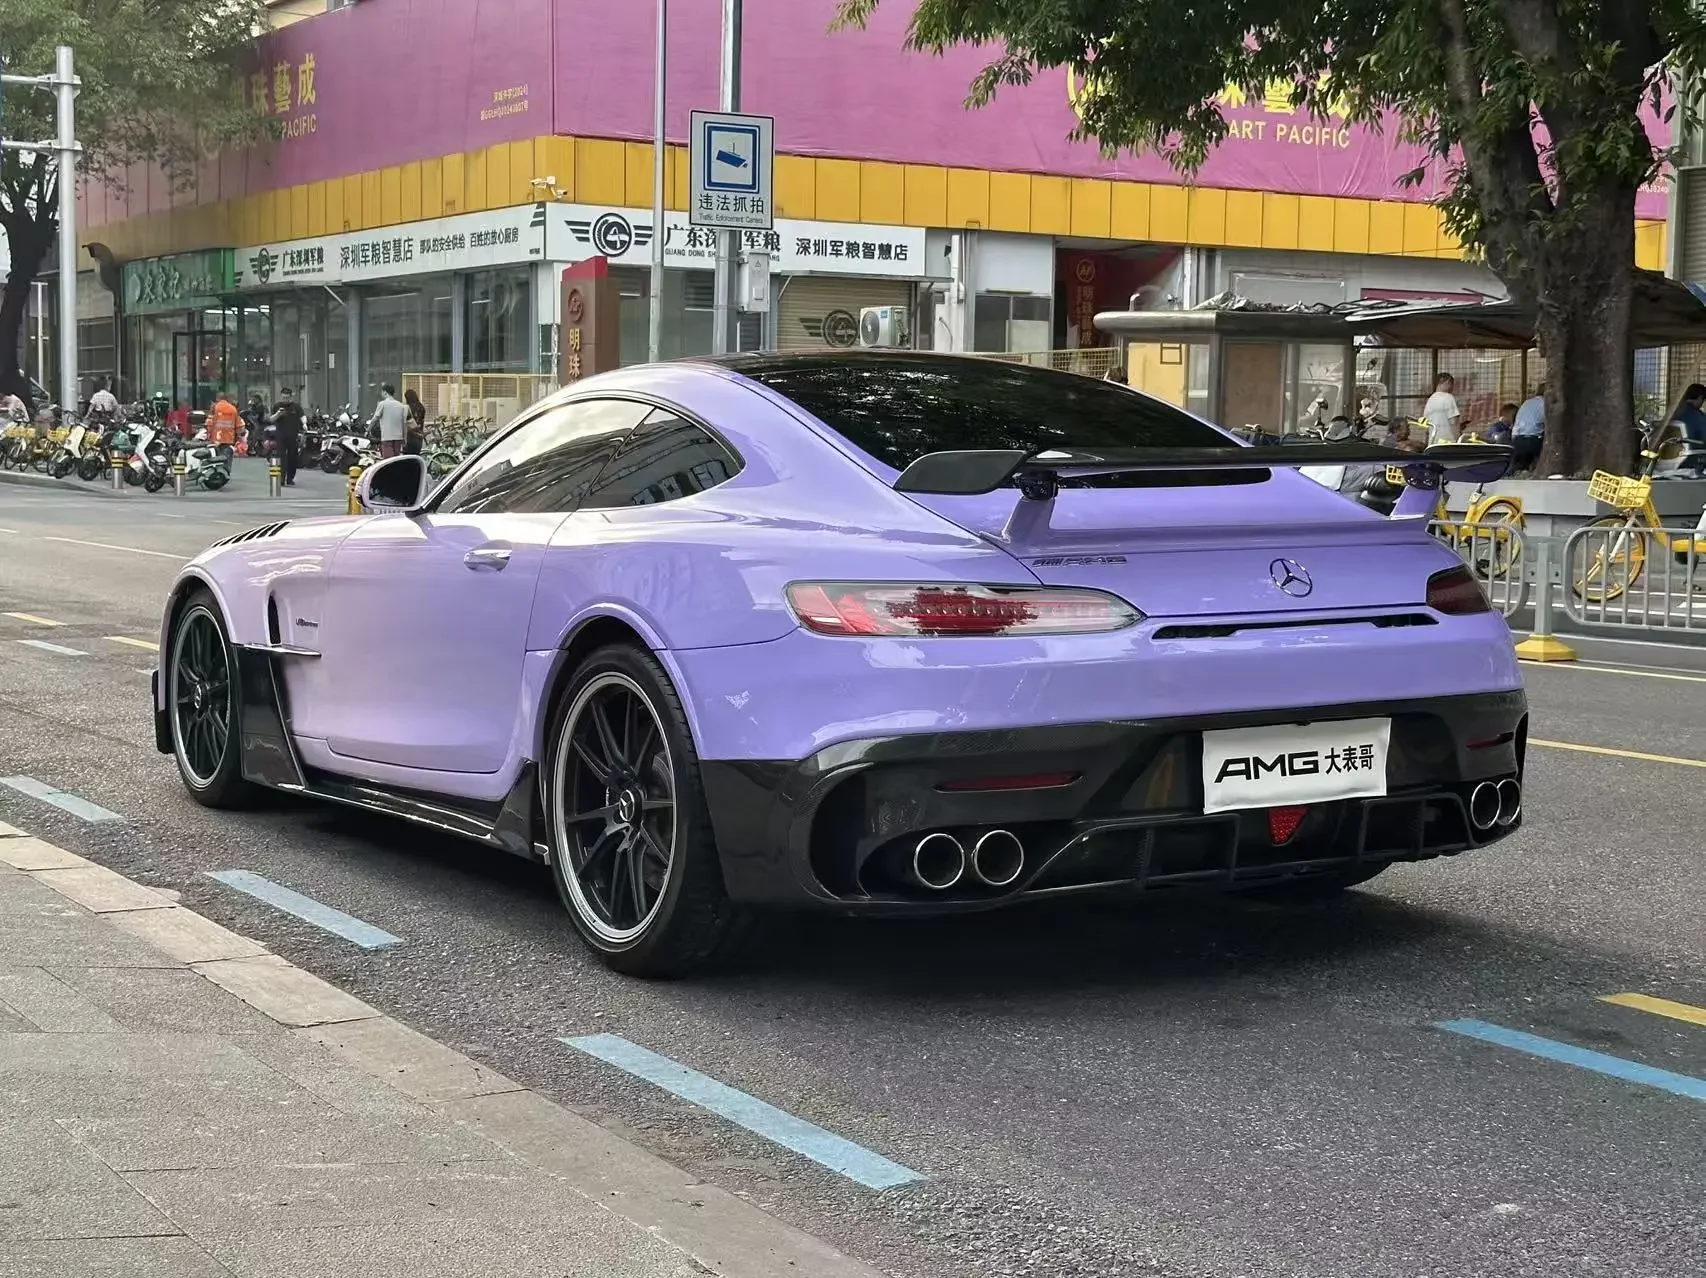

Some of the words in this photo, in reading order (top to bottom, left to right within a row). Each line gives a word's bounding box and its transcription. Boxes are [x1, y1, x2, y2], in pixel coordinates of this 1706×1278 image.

[281, 114, 316, 139] PACIFIC
[1229, 120, 1266, 140] ART
[1276, 124, 1350, 149] PACIFIC
[698, 193, 764, 214] 违法抓拍
[470, 226, 519, 247] 百姓的放心厨房
[664, 224, 781, 252] 广东深军粮
[795, 237, 908, 261] 深圳军粮智慧店
[340, 236, 414, 269] 深圳军粮智慧店
[688, 250, 705, 258] DONG
[569, 328, 580, 384] 明珠
[1214, 751, 1319, 783] AMG
[1324, 744, 1374, 775] 大表哥
